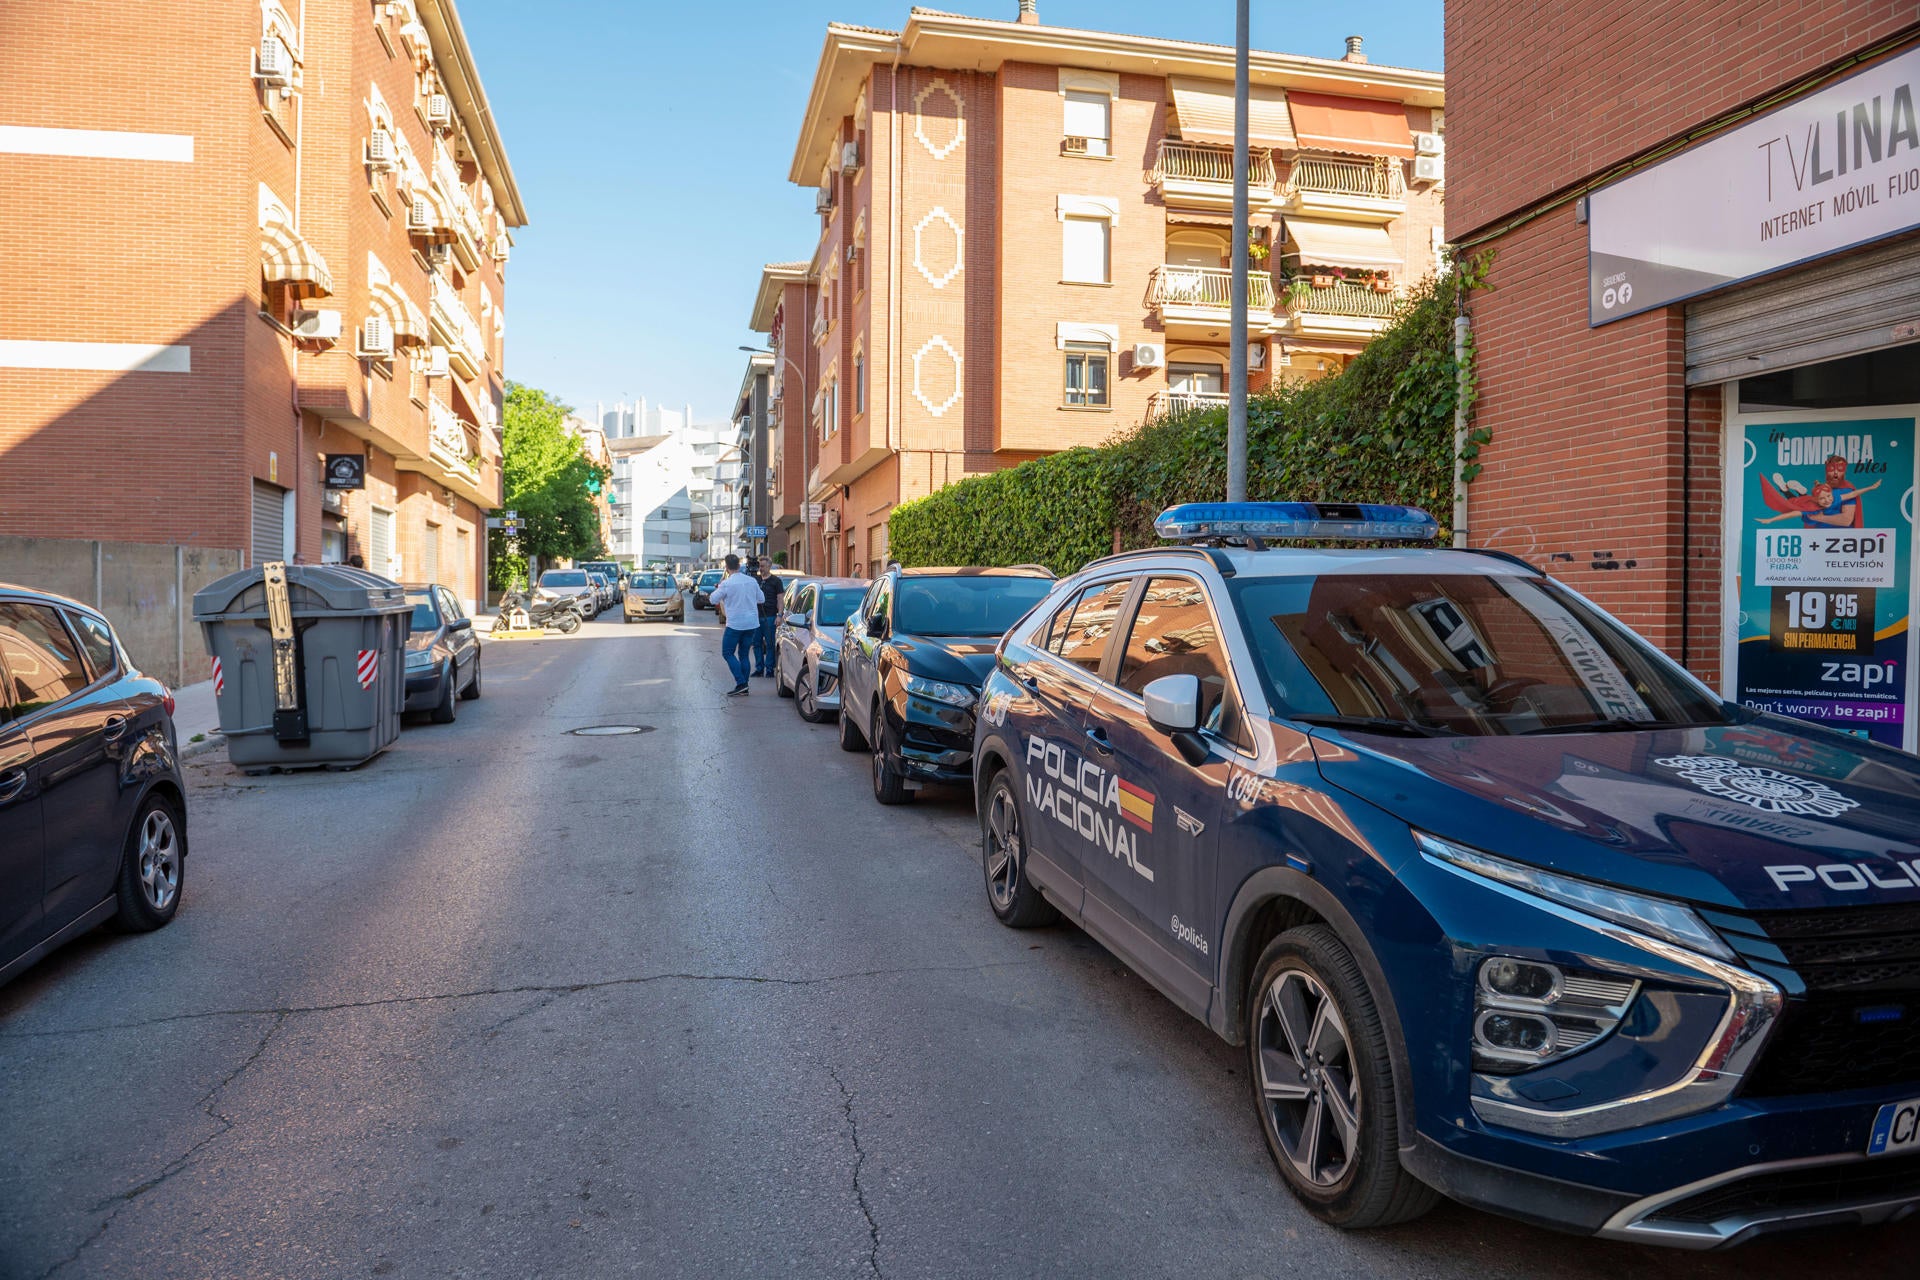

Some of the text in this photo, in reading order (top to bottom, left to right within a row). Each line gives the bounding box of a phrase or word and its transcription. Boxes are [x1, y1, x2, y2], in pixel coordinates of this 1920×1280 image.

[1760, 168, 1919, 242] INTERNET MÓVIL FIJO
[1777, 434, 1874, 466] COMPARA
[1825, 560, 1884, 568] TELEVISIÓN
[1784, 632, 1857, 650] SIN PERMANENCIA
[1834, 704, 1854, 716] be
[1856, 707, 1889, 720] zapi
[1026, 772, 1154, 883] NACIONAL
[1763, 859, 1920, 892] POLI
[1171, 915, 1208, 955] @policia
[1875, 1133, 1885, 1145] E
